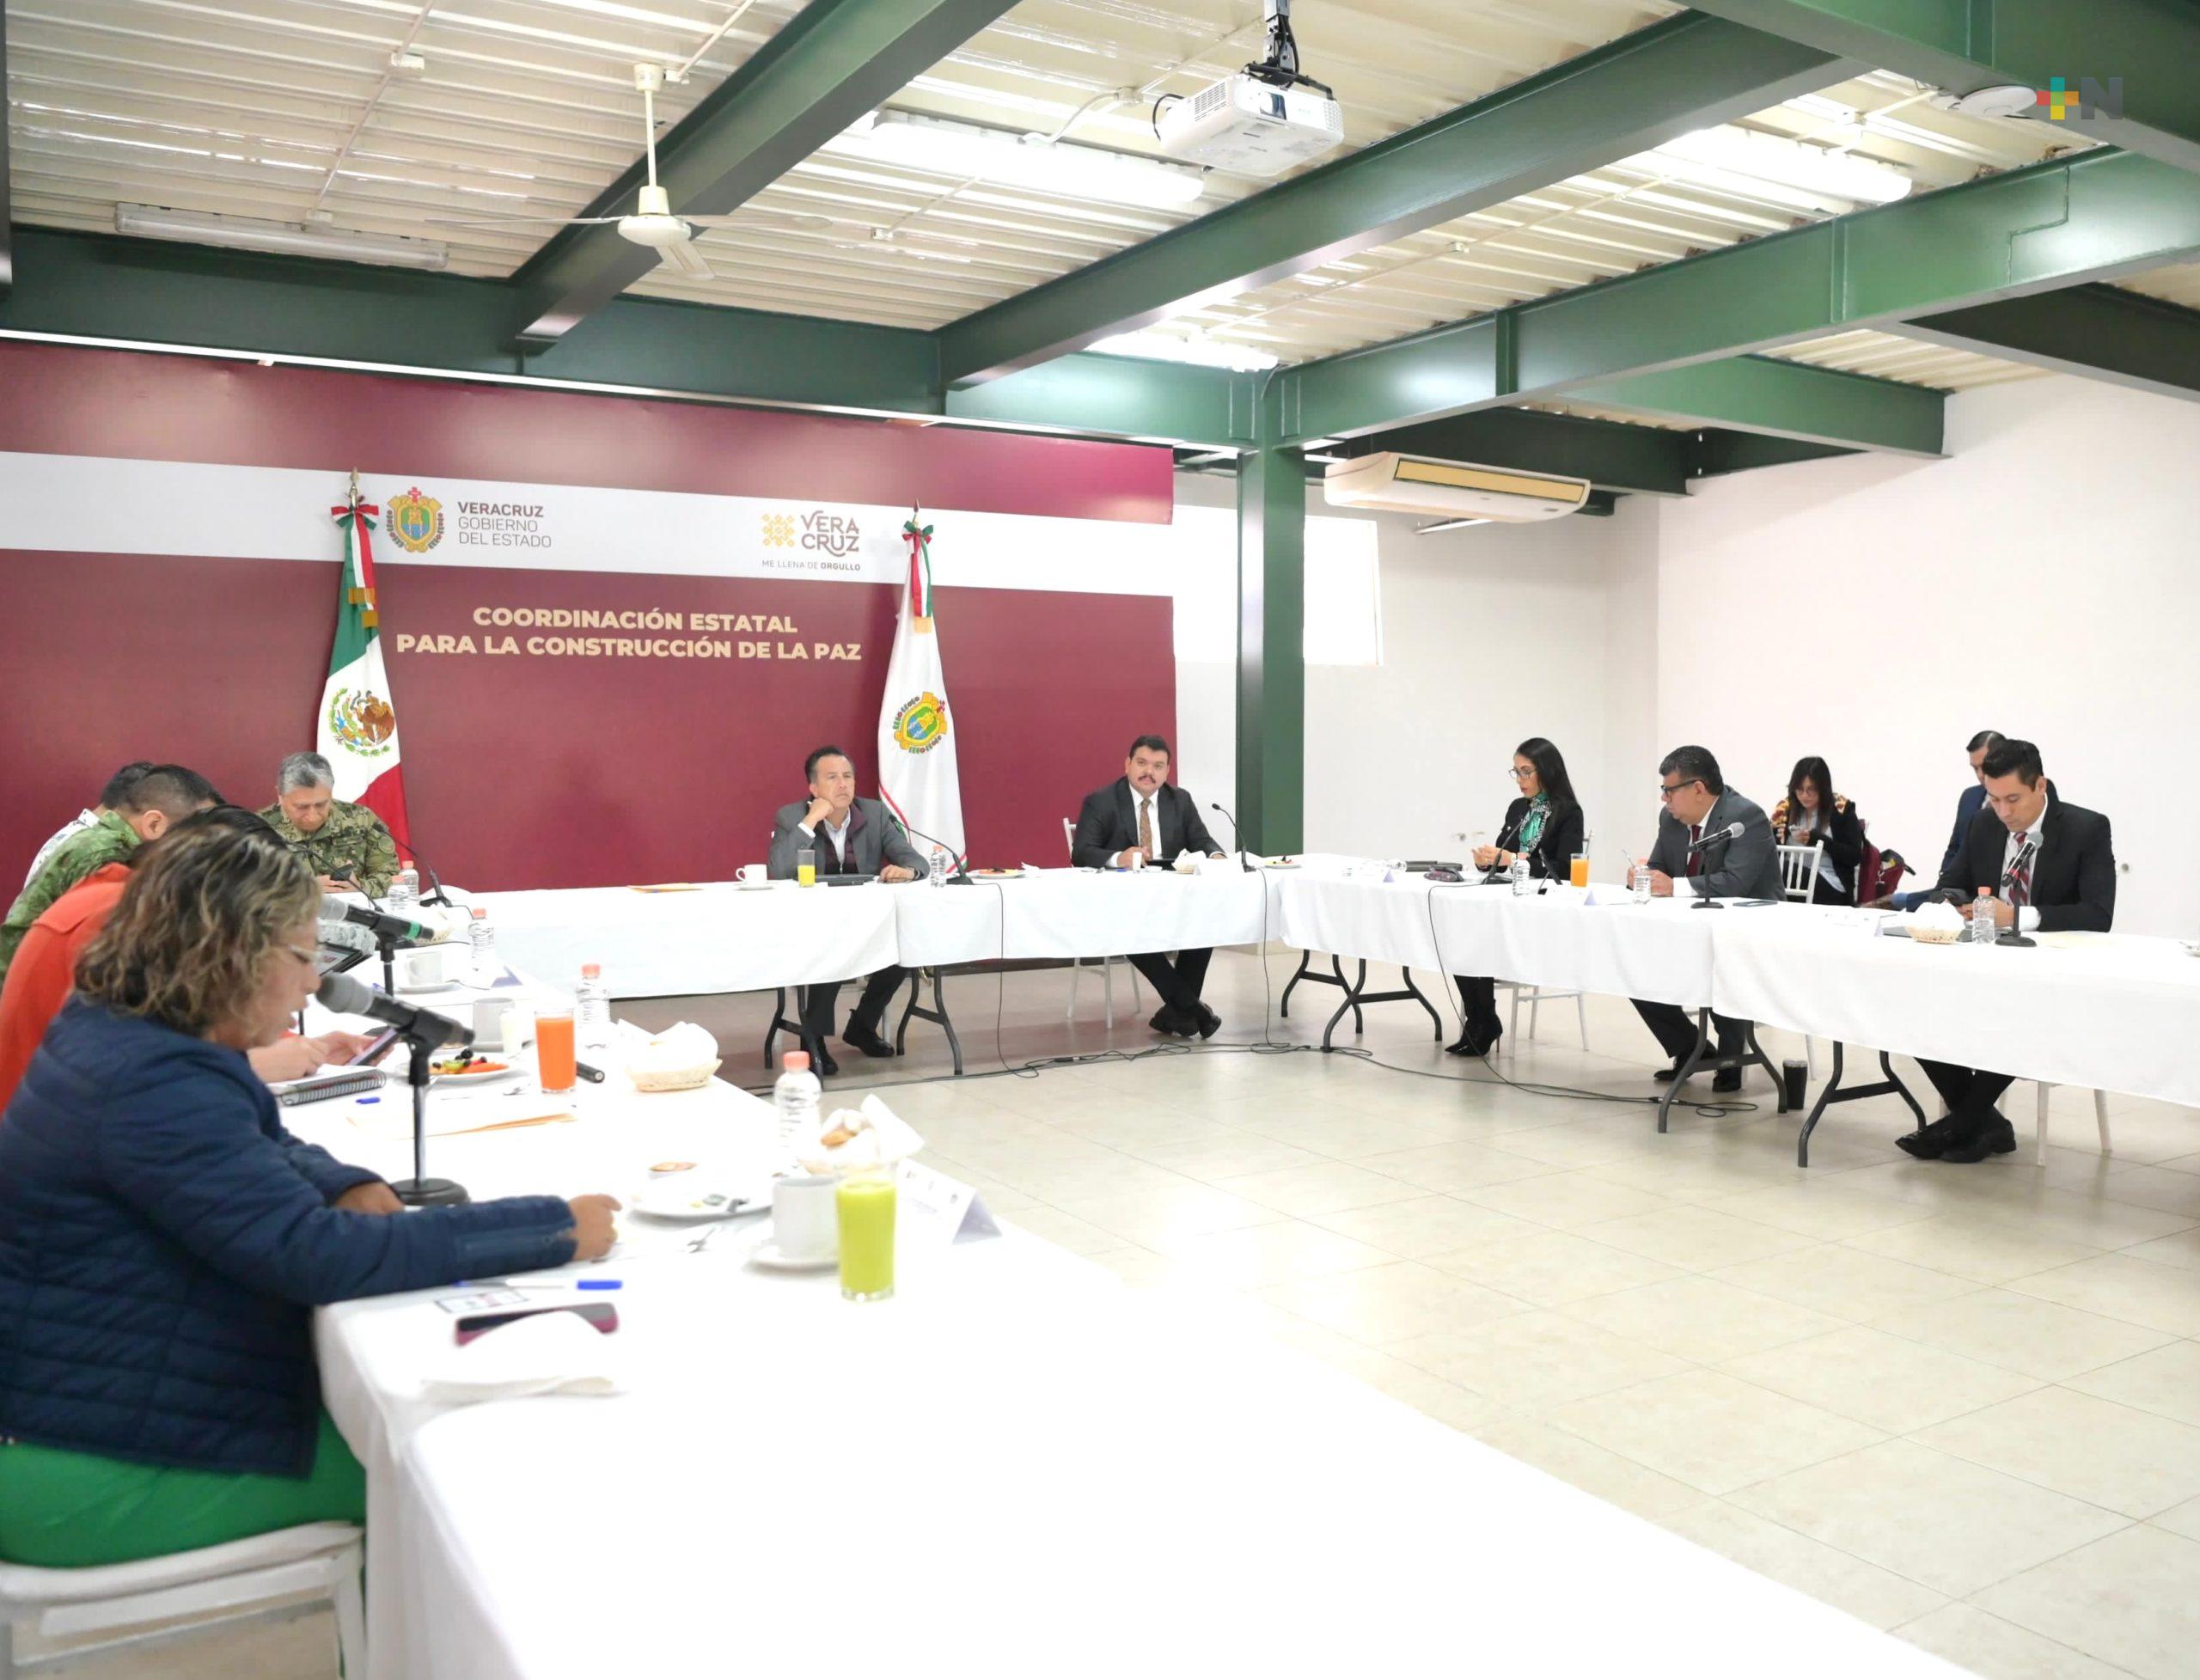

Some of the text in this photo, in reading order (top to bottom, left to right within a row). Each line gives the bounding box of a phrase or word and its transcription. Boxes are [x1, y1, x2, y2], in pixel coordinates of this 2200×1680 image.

[458, 502, 544, 517] VERACRUZ
[458, 516, 538, 533] GOBIERNO
[800, 510, 860, 534] VERA
[459, 531, 552, 548] DEL ESTADO
[801, 533, 860, 557] CRUZ
[761, 559, 861, 571] ME LLENA DE ORGULLO
[473, 607, 798, 633] COORDINACIÓN ESTATAL
[396, 634, 862, 661] PARA LA CONSTRUCCIÓN DE LA PAZ
